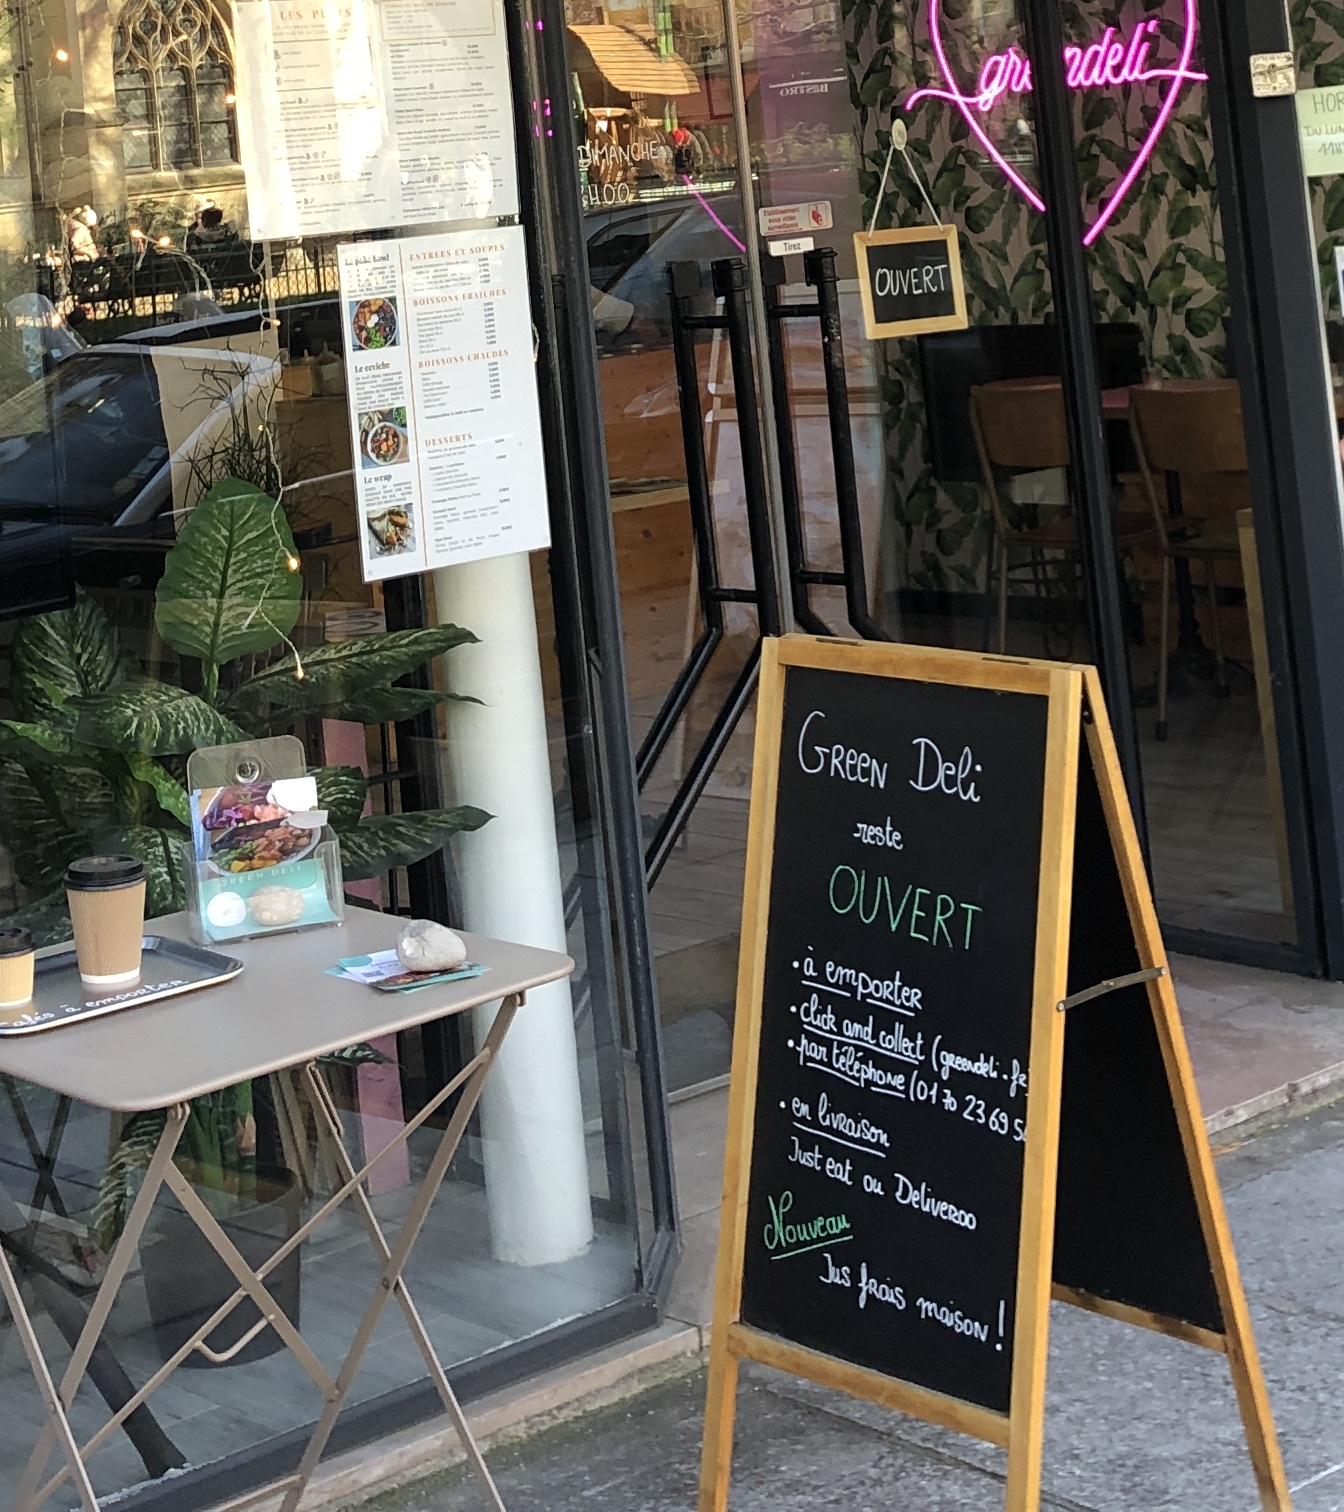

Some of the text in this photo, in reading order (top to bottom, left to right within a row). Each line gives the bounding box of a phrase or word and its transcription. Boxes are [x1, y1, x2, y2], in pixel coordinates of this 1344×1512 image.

[1304, 124, 1322, 136] DU
[409, 243, 506, 262] ENTREES ET SOUPES
[782, 242, 802, 252] Tirez
[413, 294, 460, 308] BOISSONS
[875, 263, 948, 297] OUVERT
[417, 349, 510, 369] BOISSONS CHAUDES
[424, 432, 474, 448] DESSERTS
[908, 736, 984, 803] Deli
[852, 815, 904, 851] reste
[270, 864, 301, 877] DELI
[828, 864, 984, 950] OUVERT
[824, 960, 923, 1011] emporter
[799, 992, 838, 1033] click
[842, 1014, 876, 1045] and
[878, 1021, 926, 1061] collect
[795, 1033, 828, 1067] par
[831, 1040, 907, 1091] téléphone
[962, 1094, 986, 1125] 23
[988, 1107, 1010, 1136] 69
[792, 1092, 891, 1149] en livraison
[787, 1135, 978, 1232] Just eat ou Deliveroo
[763, 1190, 852, 1251] Nouveau
[818, 1252, 852, 1289] Jus
[857, 1261, 908, 1310] frais
[916, 1296, 990, 1344] maison
